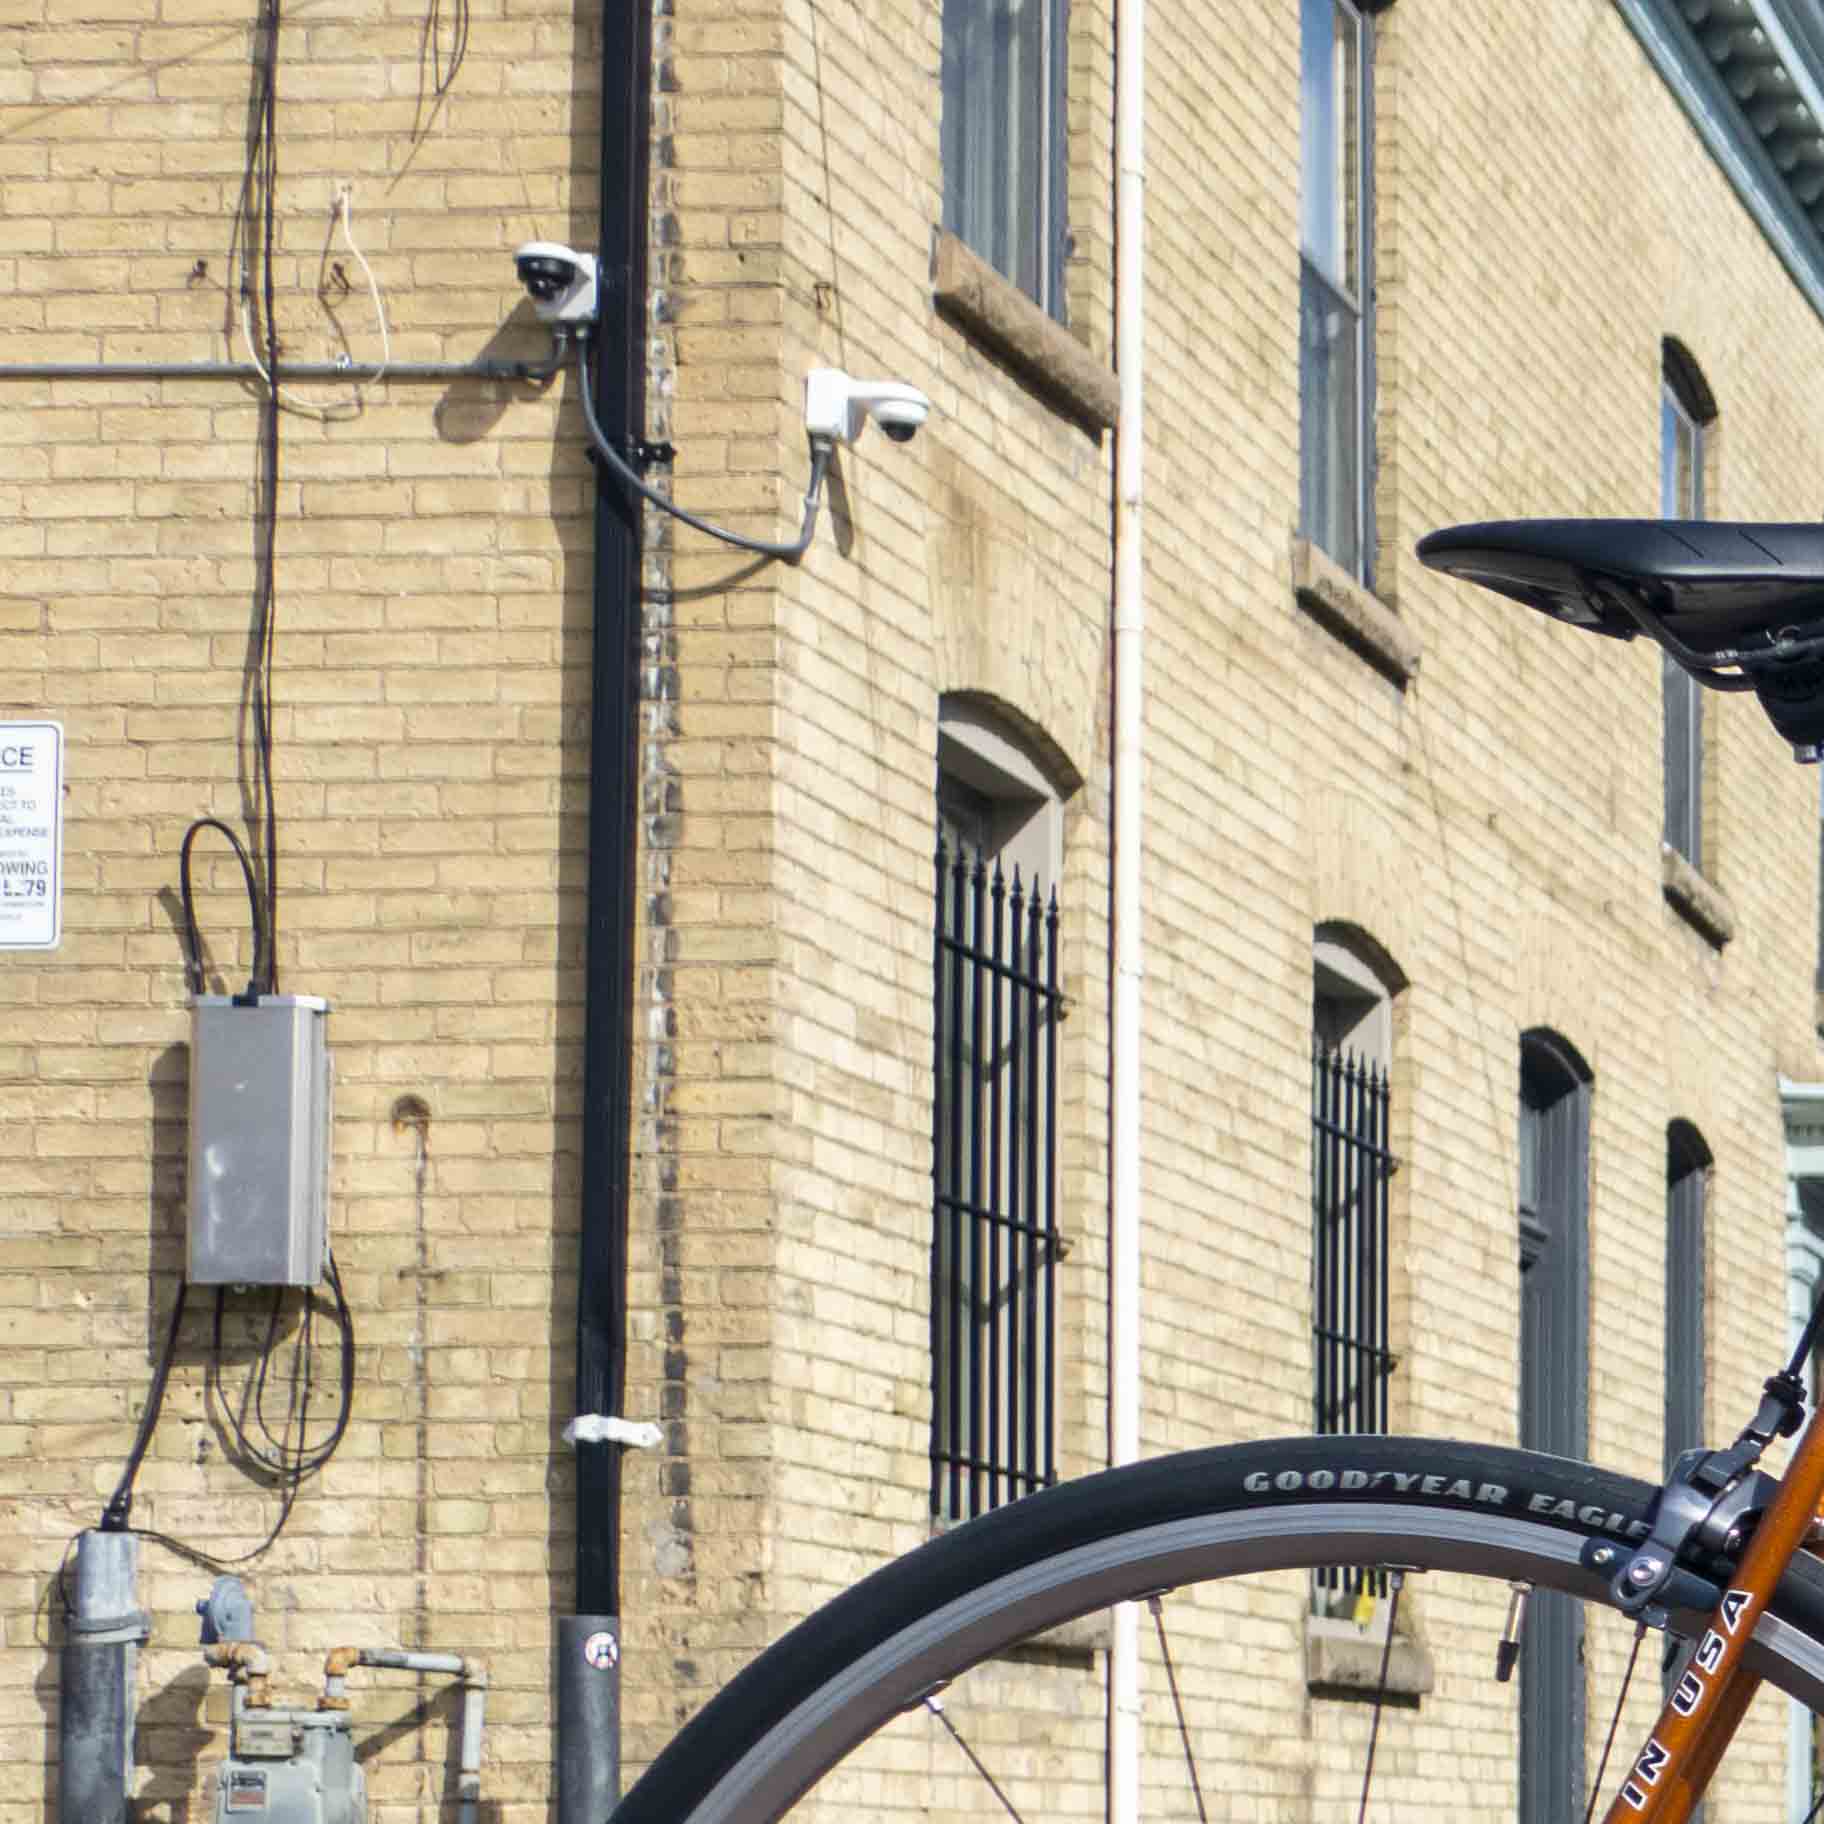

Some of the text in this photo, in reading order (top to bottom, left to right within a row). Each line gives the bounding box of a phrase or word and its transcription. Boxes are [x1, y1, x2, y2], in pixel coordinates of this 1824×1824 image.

[1242, 1470, 1509, 1505] GOODYEAR
[1621, 1738, 1672, 1810] IN
[1668, 1588, 1753, 1718] USA
